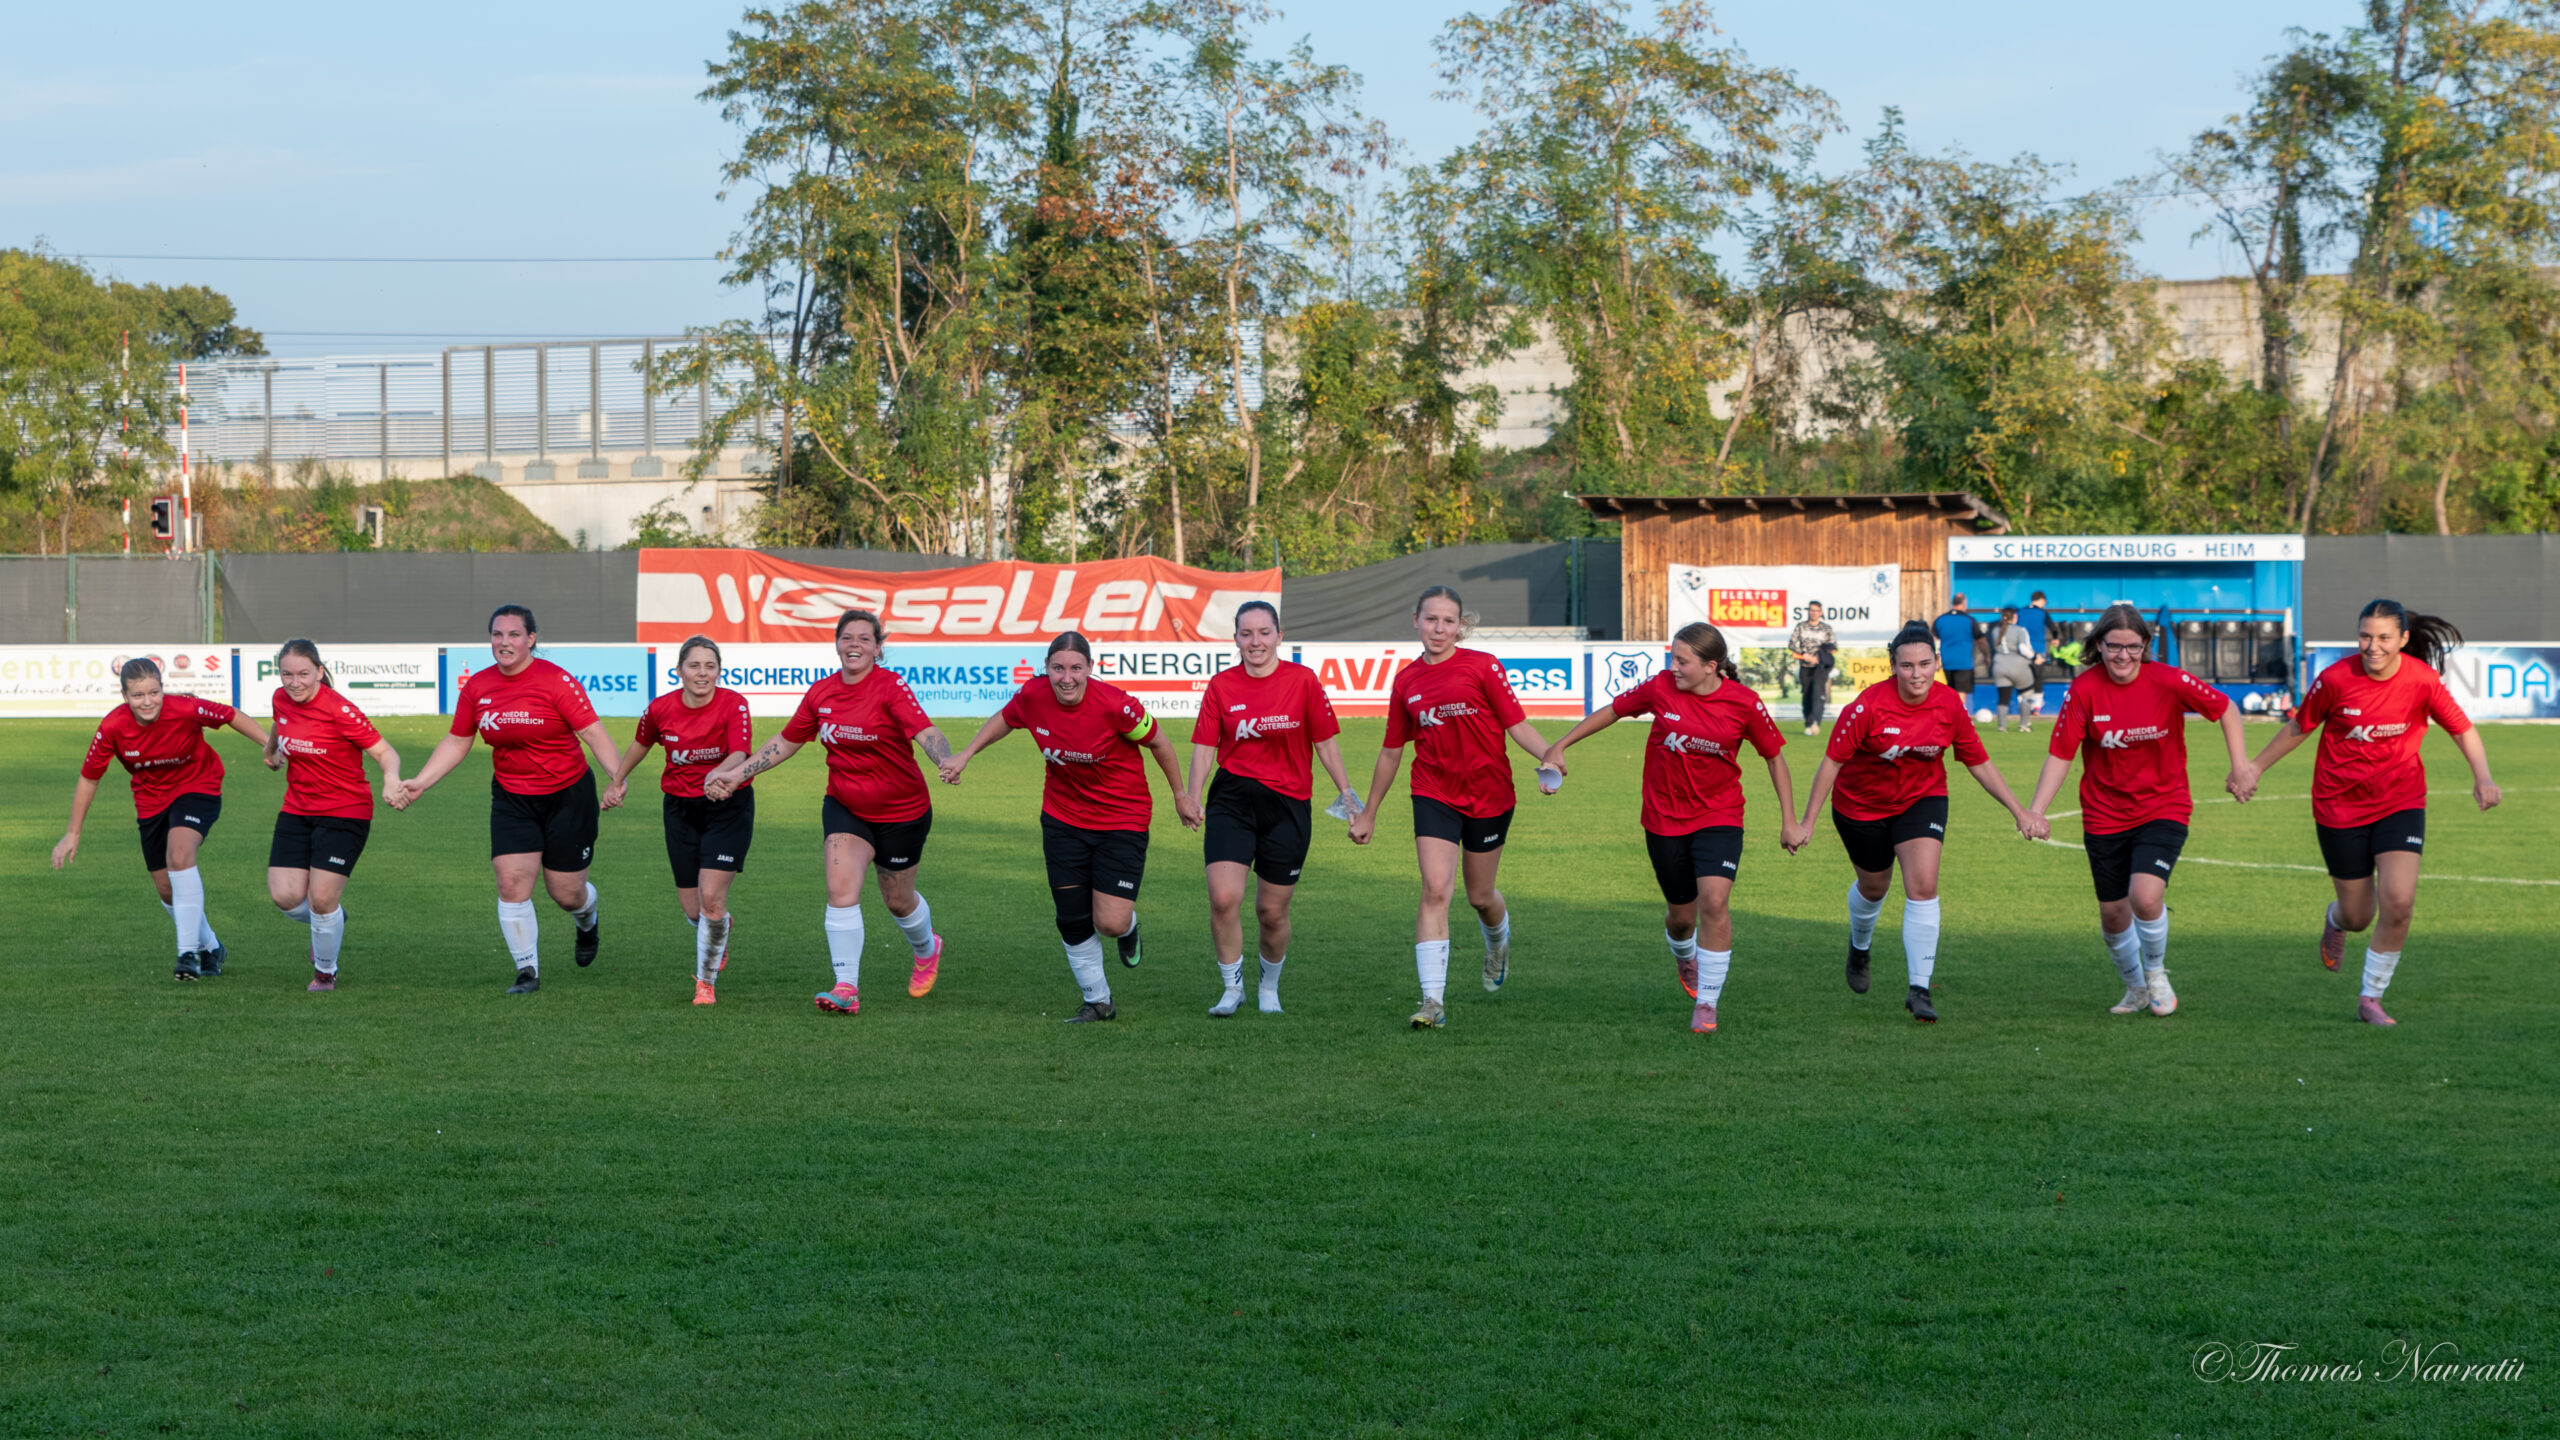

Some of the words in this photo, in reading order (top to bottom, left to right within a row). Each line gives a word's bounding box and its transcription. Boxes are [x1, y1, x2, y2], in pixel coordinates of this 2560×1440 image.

[1993, 543, 2015, 558] SC
[2021, 543, 2177, 558] HERZOGENBURG
[2205, 543, 2255, 557] HEIM
[886, 569, 1200, 636] saller
[1720, 590, 1779, 601] ELEKTRO
[1711, 590, 1783, 627] könig
[885, 665, 1009, 685] PARKASSE
[1852, 662, 1876, 674] Der
[1506, 668, 1568, 691] ess
[2443, 656, 2550, 698] NDA
[914, 687, 1016, 703] genburg-Neule
[1439, 702, 1467, 711] NIEDER
[1261, 715, 1289, 724] NIEDER
[1664, 711, 1681, 721] JAKO
[1235, 718, 1262, 741] AK
[2127, 726, 2157, 736] NIEDER
[1663, 731, 1688, 753] AK
[1691, 736, 1721, 750] NIEDER
[692, 746, 720, 756] NIEDER
[1064, 750, 1093, 760] NIEDER
